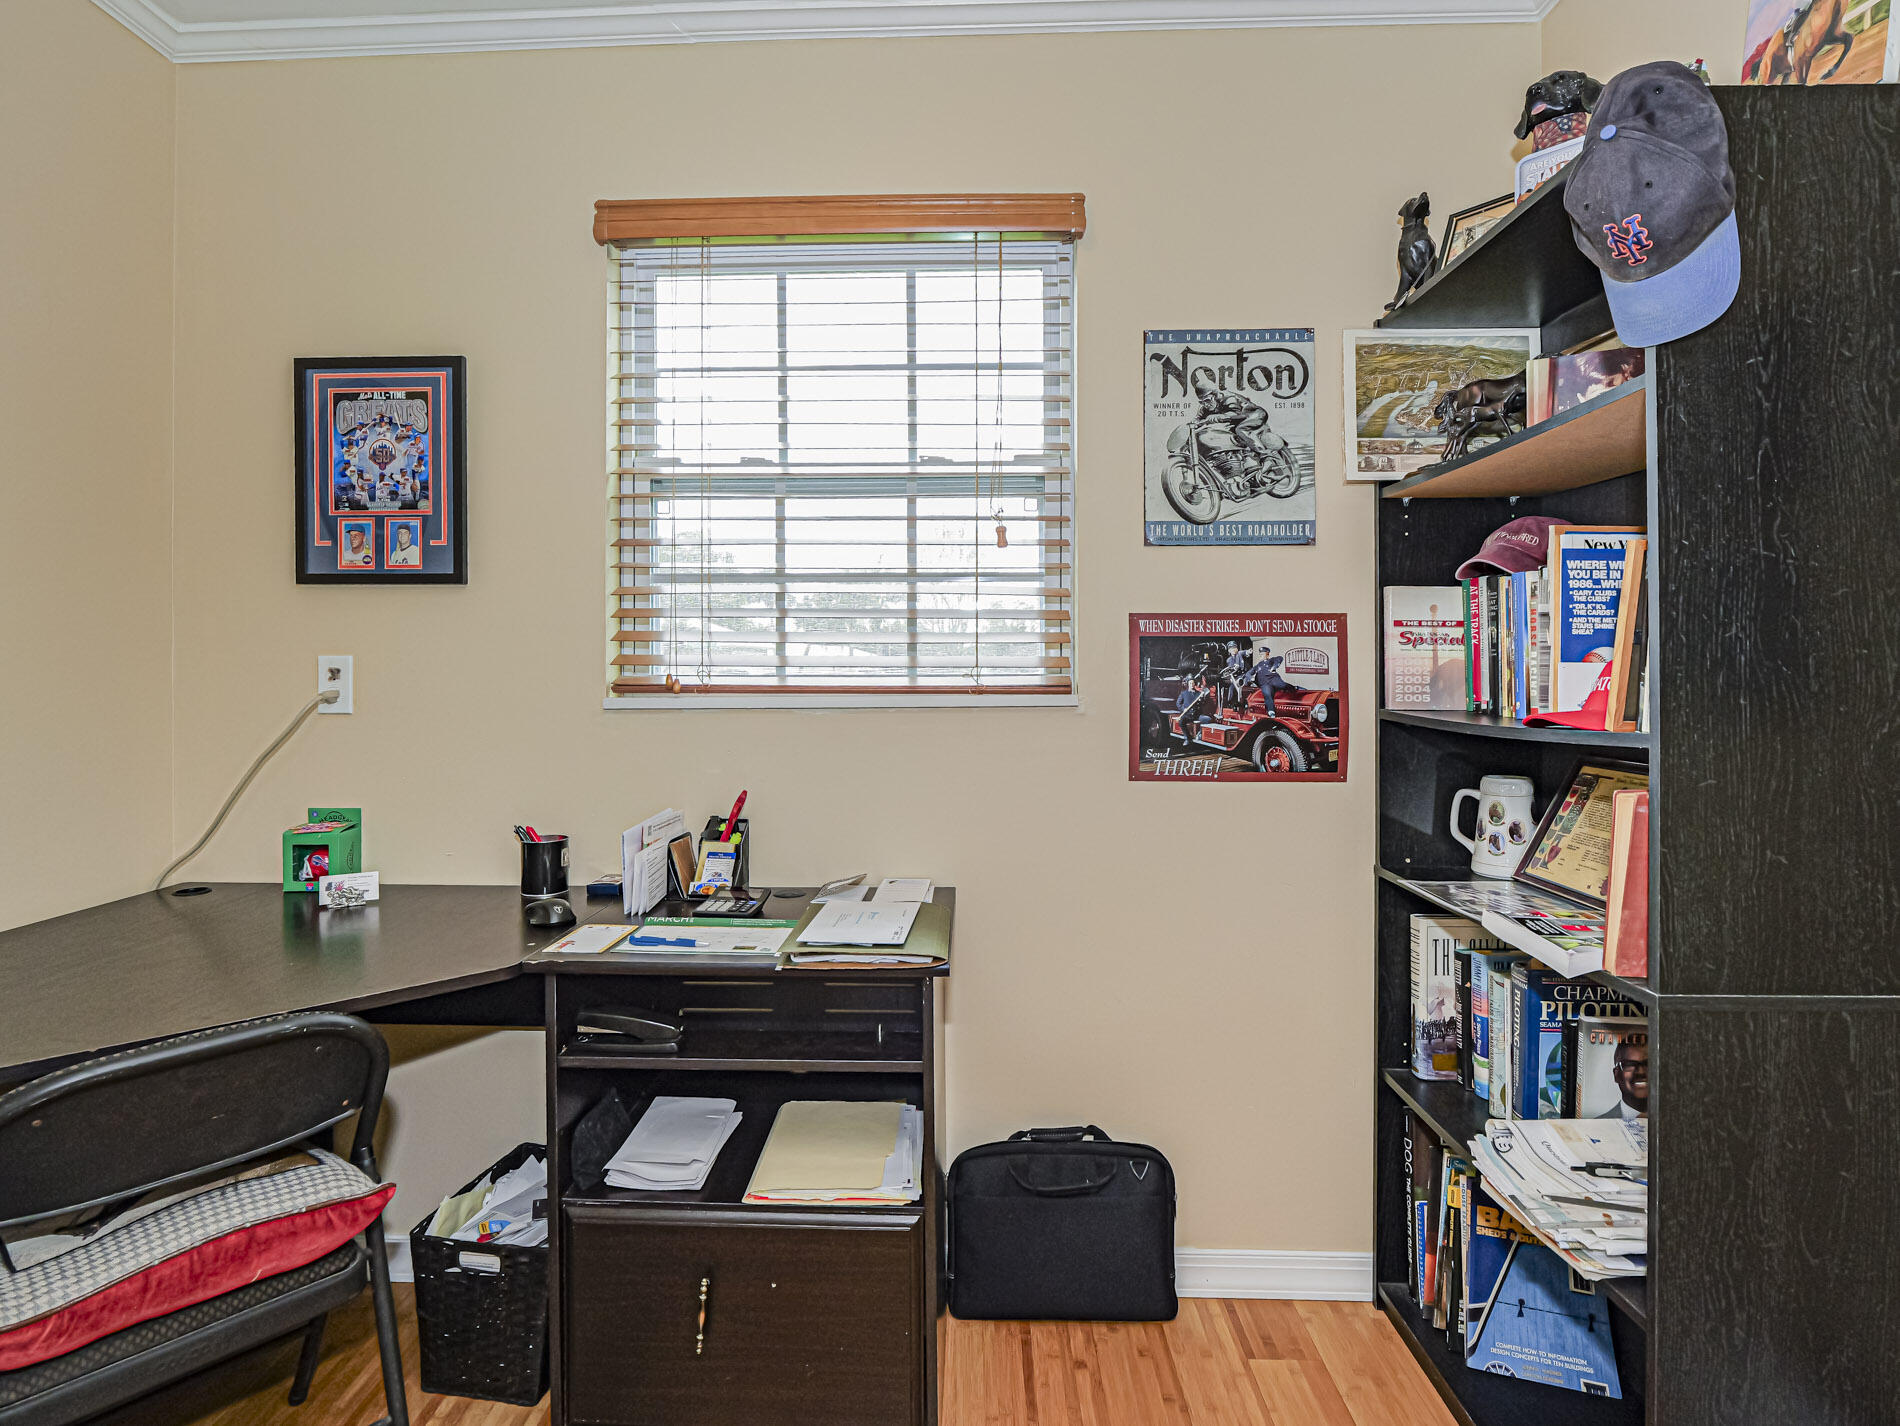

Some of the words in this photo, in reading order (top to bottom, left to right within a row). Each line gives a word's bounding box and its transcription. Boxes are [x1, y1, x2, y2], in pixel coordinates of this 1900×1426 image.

[1149, 333, 1173, 342] THE
[1186, 332, 1309, 342] UNAPROACHABLE
[1150, 346, 1309, 399] Norton
[373, 391, 406, 400] ALL-TIME
[336, 398, 428, 435] GREATS
[375, 448, 390, 463] 50
[1150, 524, 1167, 537] THE
[1172, 524, 1214, 537] WORLD'S
[1219, 524, 1242, 536] BEST
[1247, 523, 1311, 536] ROADHOLDER
[1566, 560, 1607, 570] WHERE
[1568, 569, 1591, 579] YOU
[1592, 569, 1608, 579] BE
[1609, 569, 1621, 579] IN
[1470, 586, 1479, 595] AT
[1470, 598, 1479, 615] THE
[1139, 619, 1164, 633] WHEN
[1165, 619, 1205, 633] DISASTER
[1272, 619, 1295, 632] SEND
[1295, 620, 1302, 632] A
[1303, 619, 1337, 633] STOOGE
[1471, 617, 1480, 645] TRACK
[1398, 630, 1466, 649] Special
[1395, 666, 1431, 675] 2002
[1395, 675, 1431, 684] 2003
[1530, 650, 1538, 697] RACING
[1395, 685, 1431, 694] 2004
[1395, 694, 1431, 703] 2005
[1145, 747, 1171, 758] Send
[1154, 756, 1223, 779] THREE!
[1410, 926, 1420, 945] THE
[1410, 948, 1420, 976] CIVIL
[1433, 939, 1460, 976] TH
[1454, 960, 1462, 986] BUFFETT
[1472, 957, 1482, 983] JIMMY
[1472, 984, 1482, 1013] BUFFETT
[1553, 985, 1624, 1001] CHAPM
[1513, 988, 1521, 1048] PILOTING
[1403, 1137, 1413, 1175] DOG
[1476, 1226, 1507, 1239] SHEDS
[1490, 1347, 1511, 1357] DESIGN
[1511, 1351, 1540, 1363] CONCEPTS
[1553, 1360, 1564, 1368] TEN
[1564, 1363, 1594, 1375] BUILDINGS
[1495, 1342, 1522, 1352] COMPLETE
[1547, 1352, 1588, 1366] INFORMATION
